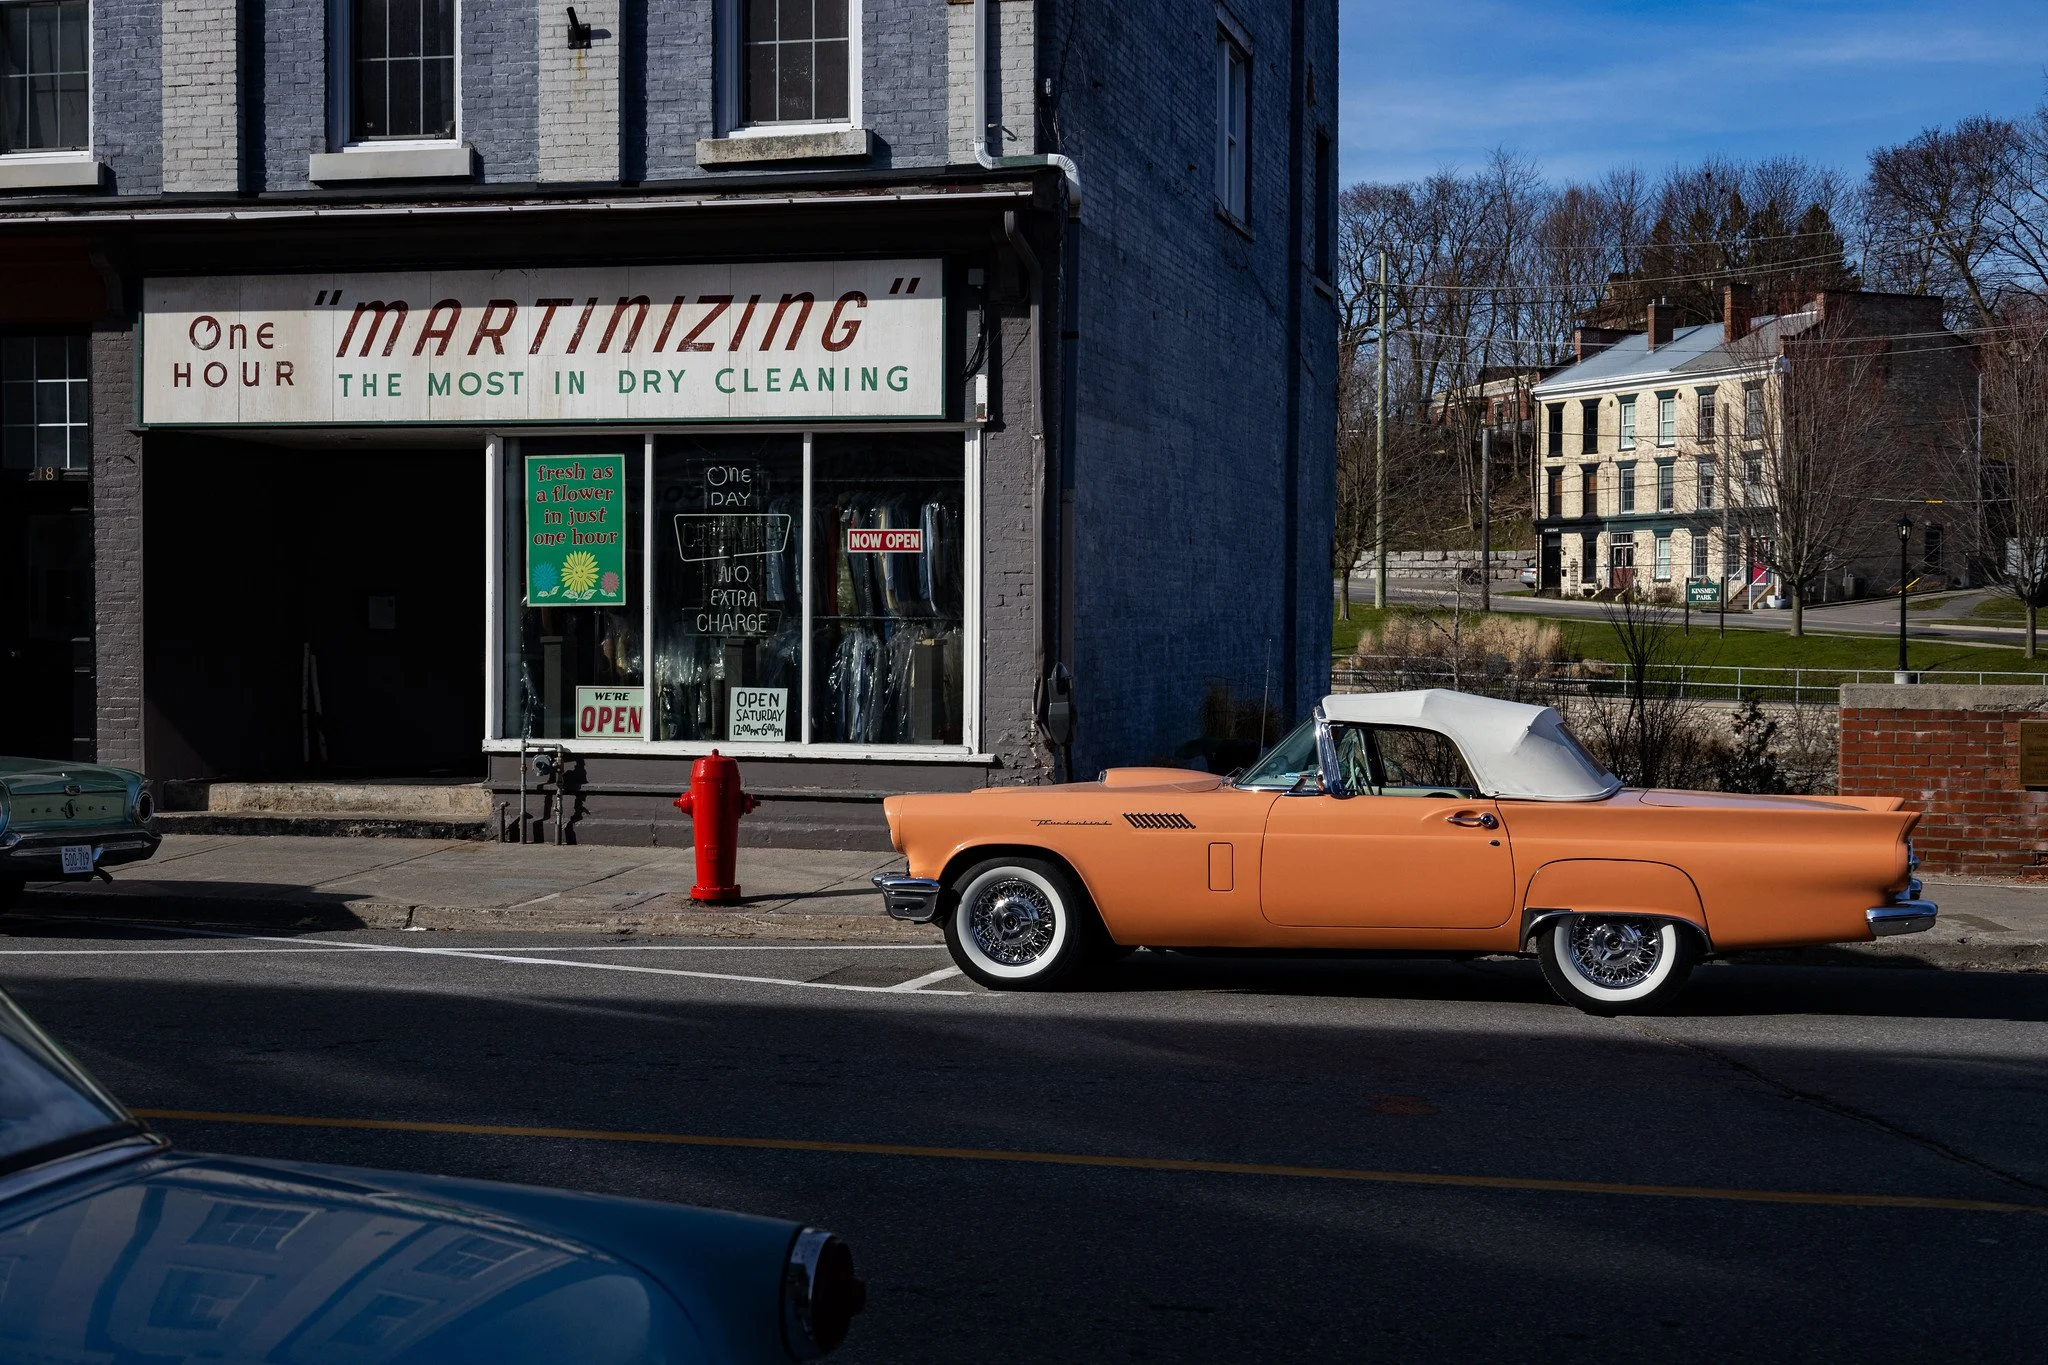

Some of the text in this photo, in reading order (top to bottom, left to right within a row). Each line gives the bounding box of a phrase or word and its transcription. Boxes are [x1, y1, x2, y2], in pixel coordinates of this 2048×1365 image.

[188, 315, 274, 351] One
[173, 361, 295, 388] HOUR
[338, 365, 909, 398] THE MOST IN DRY CLEANING
[537, 462, 613, 482] fresh as
[536, 484, 614, 503] a flower
[710, 491, 751, 506] DAY
[544, 507, 607, 526] in just
[533, 528, 618, 546] one hour
[851, 533, 919, 548] NOW OPEN
[718, 565, 750, 583] NO
[710, 588, 758, 607] EXTRA
[696, 613, 768, 633] CHARGE
[595, 691, 631, 701] WE'RE
[737, 691, 780, 708] OPEN
[581, 705, 643, 733] OPEN
[735, 708, 785, 722] SATURDAY
